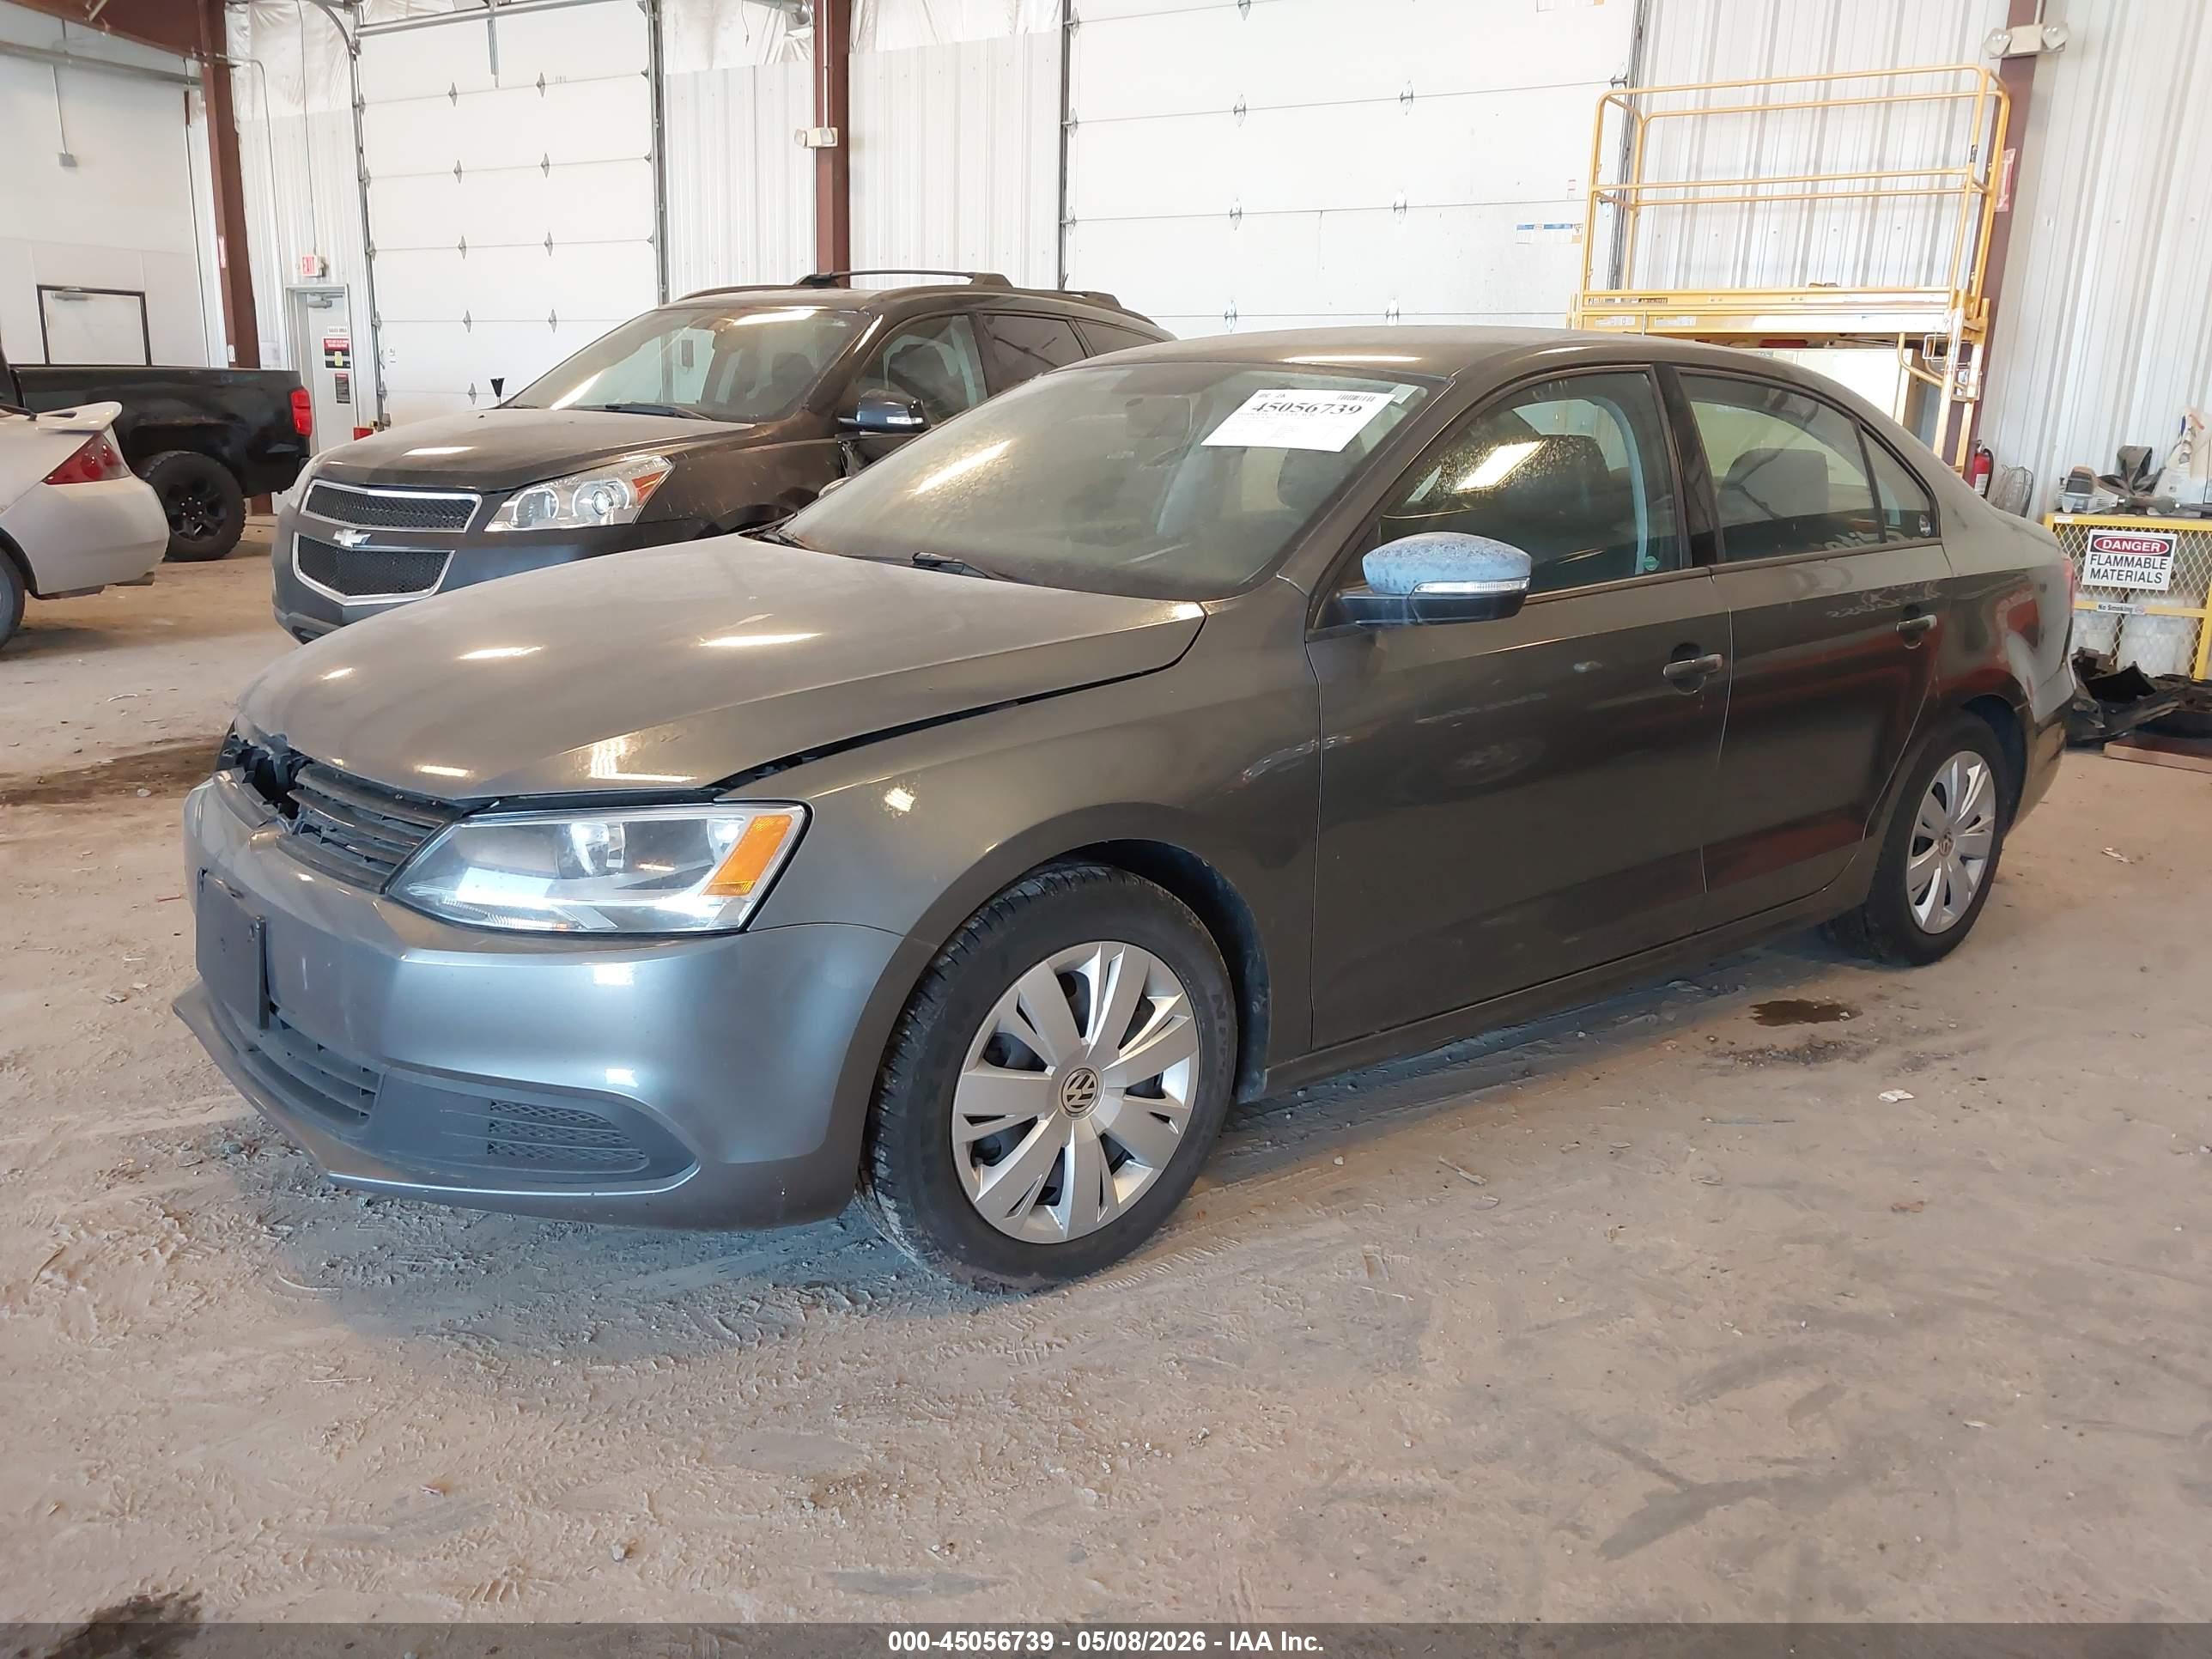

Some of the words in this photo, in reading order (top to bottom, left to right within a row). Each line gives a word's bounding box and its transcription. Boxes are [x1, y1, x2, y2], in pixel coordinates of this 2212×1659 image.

[1252, 401, 1363, 415] 45056739
[2102, 539, 2160, 552] DANGER
[2089, 554, 2168, 570] FLAMMABLE
[2089, 568, 2163, 584] MATERIALS
[2107, 604, 2133, 613] Smoking
